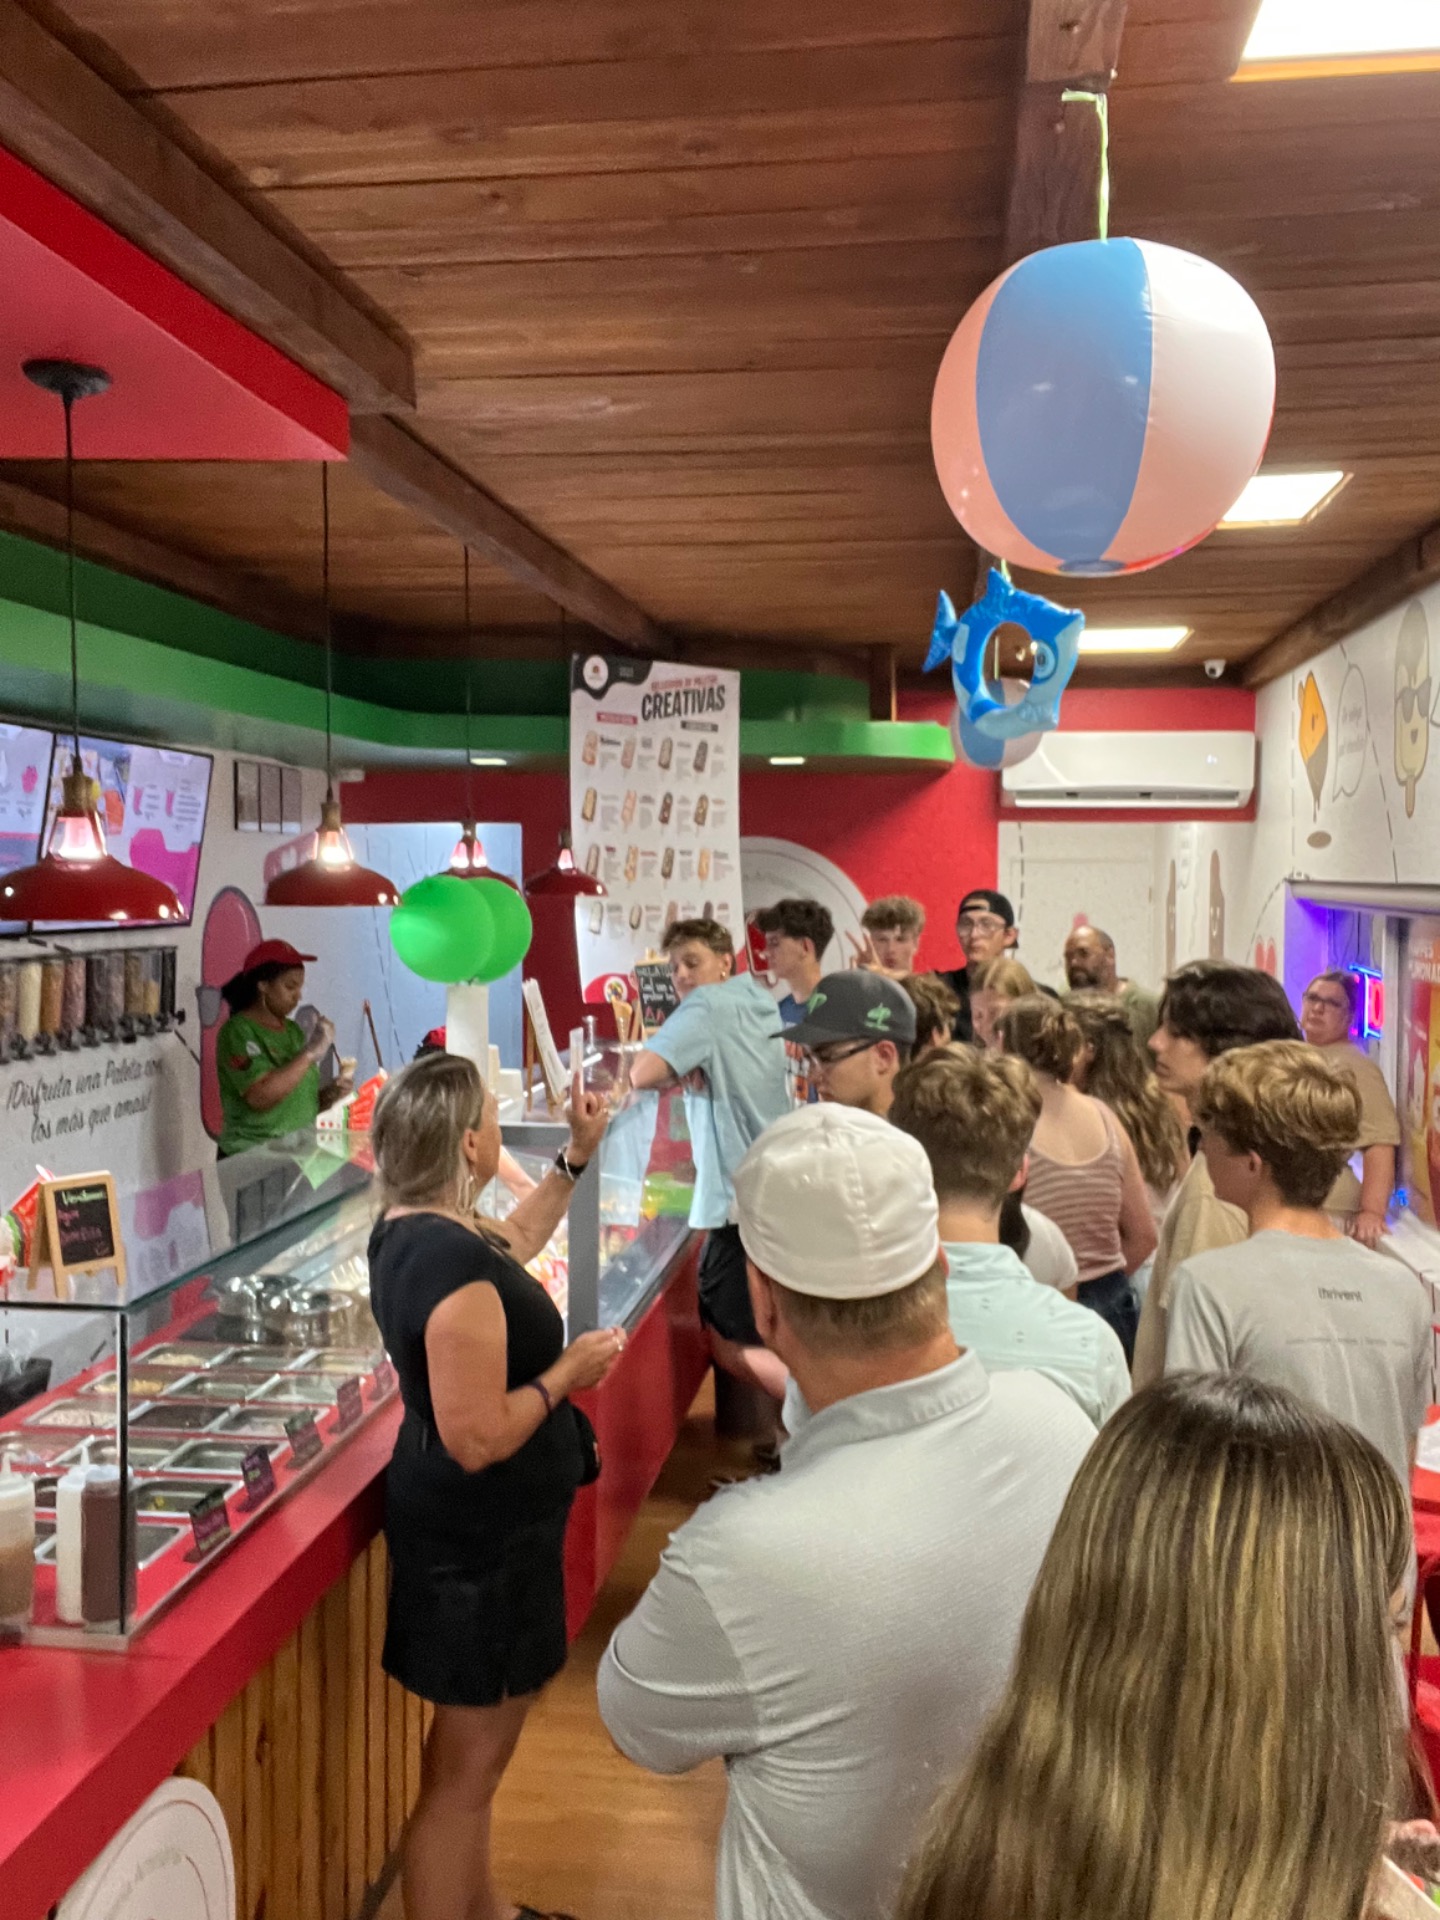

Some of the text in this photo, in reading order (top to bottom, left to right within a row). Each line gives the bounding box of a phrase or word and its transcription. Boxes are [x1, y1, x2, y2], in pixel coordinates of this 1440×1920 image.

[641, 684, 726, 721] CREATIVAS
[75, 1072, 101, 1093] una
[88, 1104, 111, 1136] que
